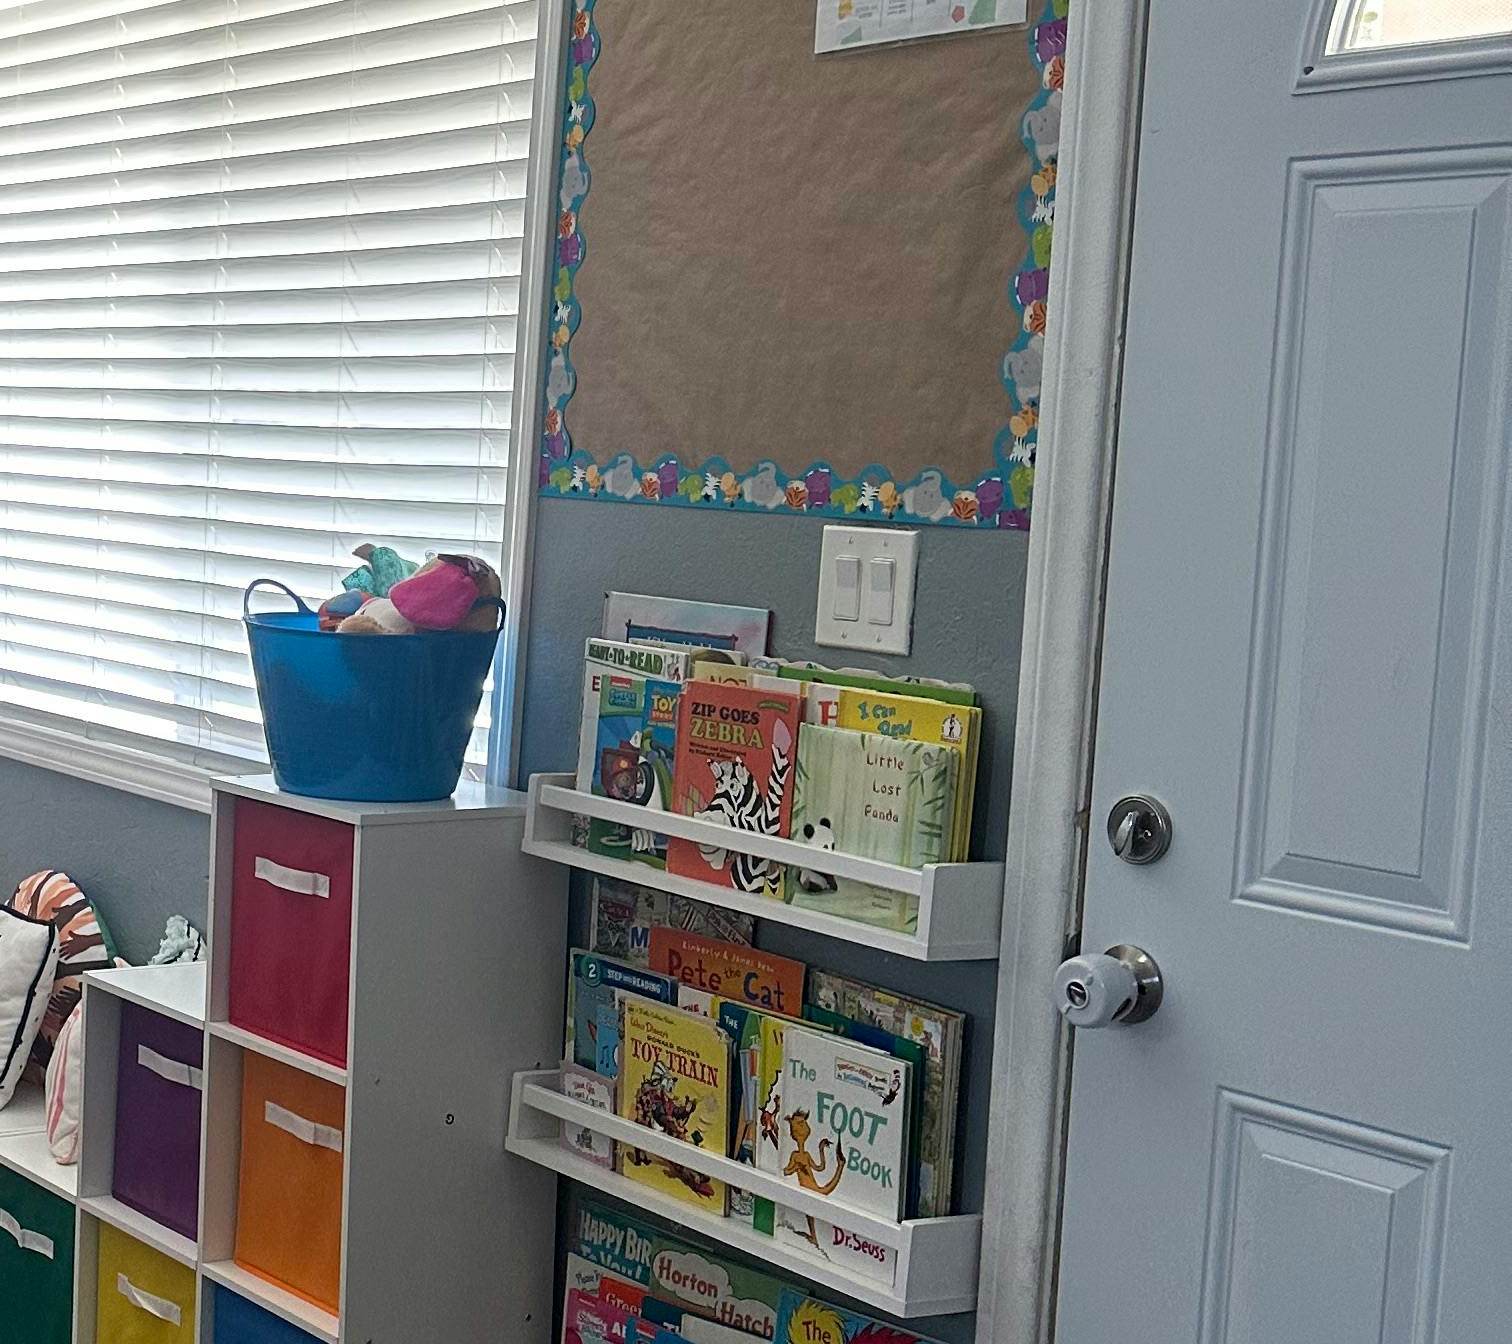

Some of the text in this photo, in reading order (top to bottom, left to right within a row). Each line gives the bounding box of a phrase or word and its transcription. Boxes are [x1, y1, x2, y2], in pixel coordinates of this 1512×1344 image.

[651, 694, 677, 713] TOY
[691, 702, 760, 725] ZIP GOES
[690, 716, 764, 749] ZEBRA
[866, 752, 904, 771] Little
[872, 778, 902, 797] Lost
[864, 803, 899, 823] Panda
[587, 963, 597, 978] 2
[668, 947, 785, 1012] Pete the Cat
[724, 1015, 739, 1030] THE
[631, 1037, 719, 1088] TOY TRAIN
[789, 1058, 817, 1082] The
[817, 1091, 888, 1146] FOOT
[580, 1208, 625, 1256] HAPPY
[832, 1224, 886, 1263] Dr. Seuss
[658, 1255, 719, 1299] Horton
[720, 1301, 774, 1340] Hatch
[802, 1320, 832, 1344] The
